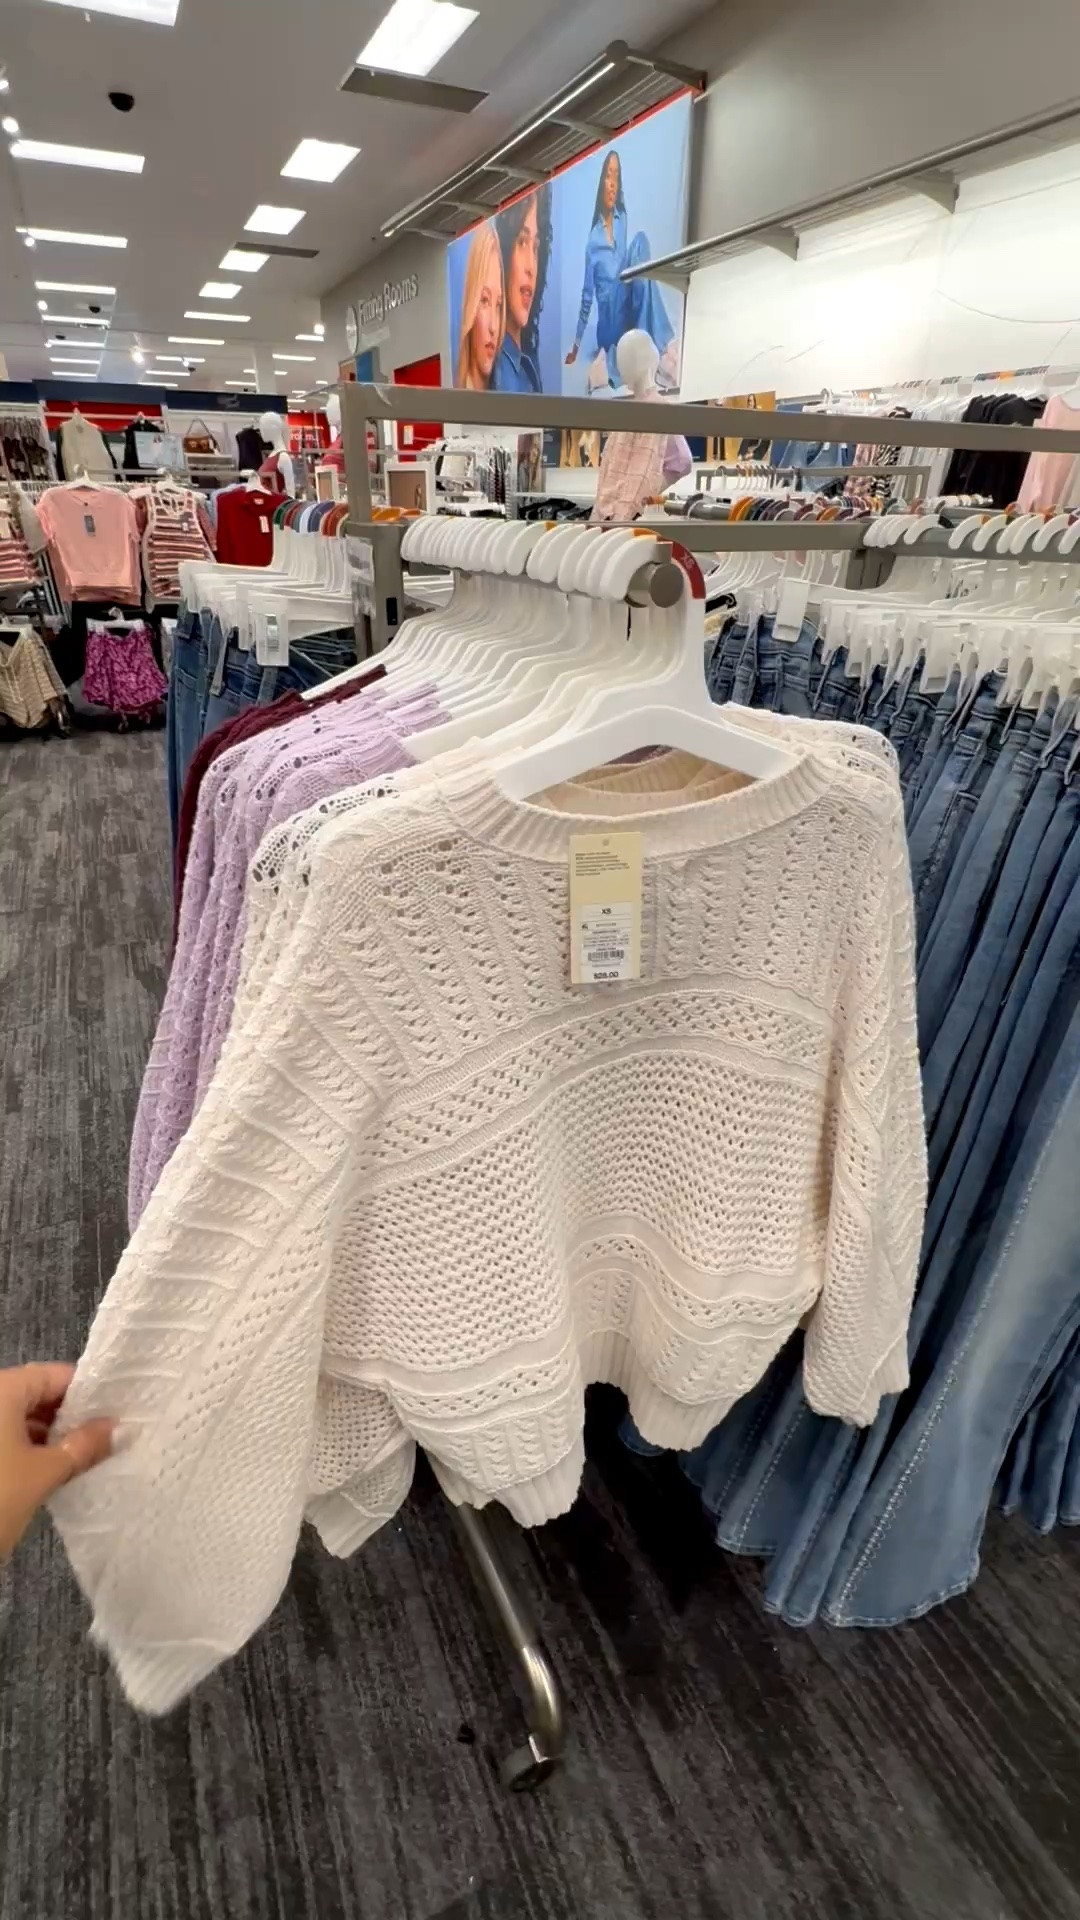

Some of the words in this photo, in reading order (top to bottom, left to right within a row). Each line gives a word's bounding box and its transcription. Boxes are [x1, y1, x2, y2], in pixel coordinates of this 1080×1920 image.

[358, 295, 384, 326] Fitting
[384, 274, 418, 311] Rooms
[601, 907, 612, 915] XS
